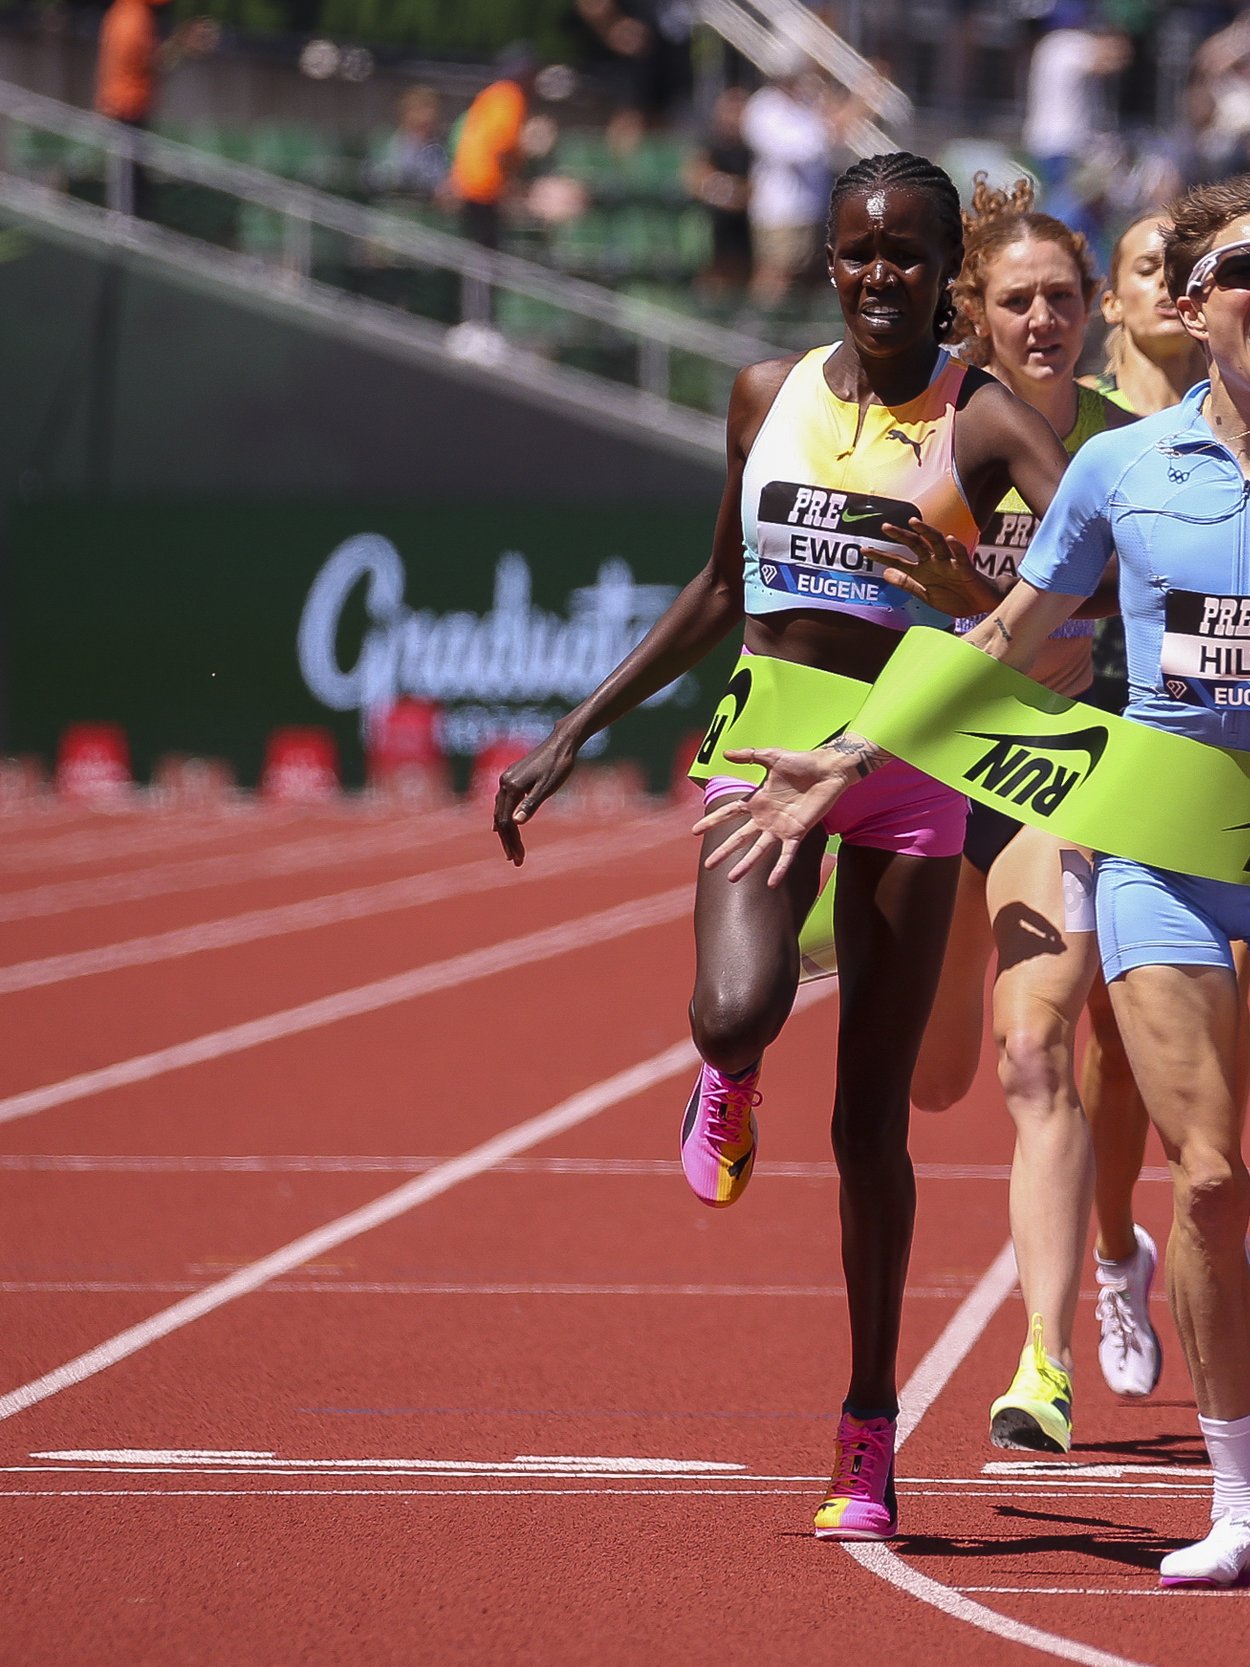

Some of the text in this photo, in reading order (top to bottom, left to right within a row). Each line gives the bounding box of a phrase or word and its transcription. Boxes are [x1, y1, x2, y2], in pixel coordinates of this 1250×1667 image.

[787, 488, 848, 530] PRE
[797, 573, 880, 601] EUGENE
[962, 741, 1081, 818] RUN
